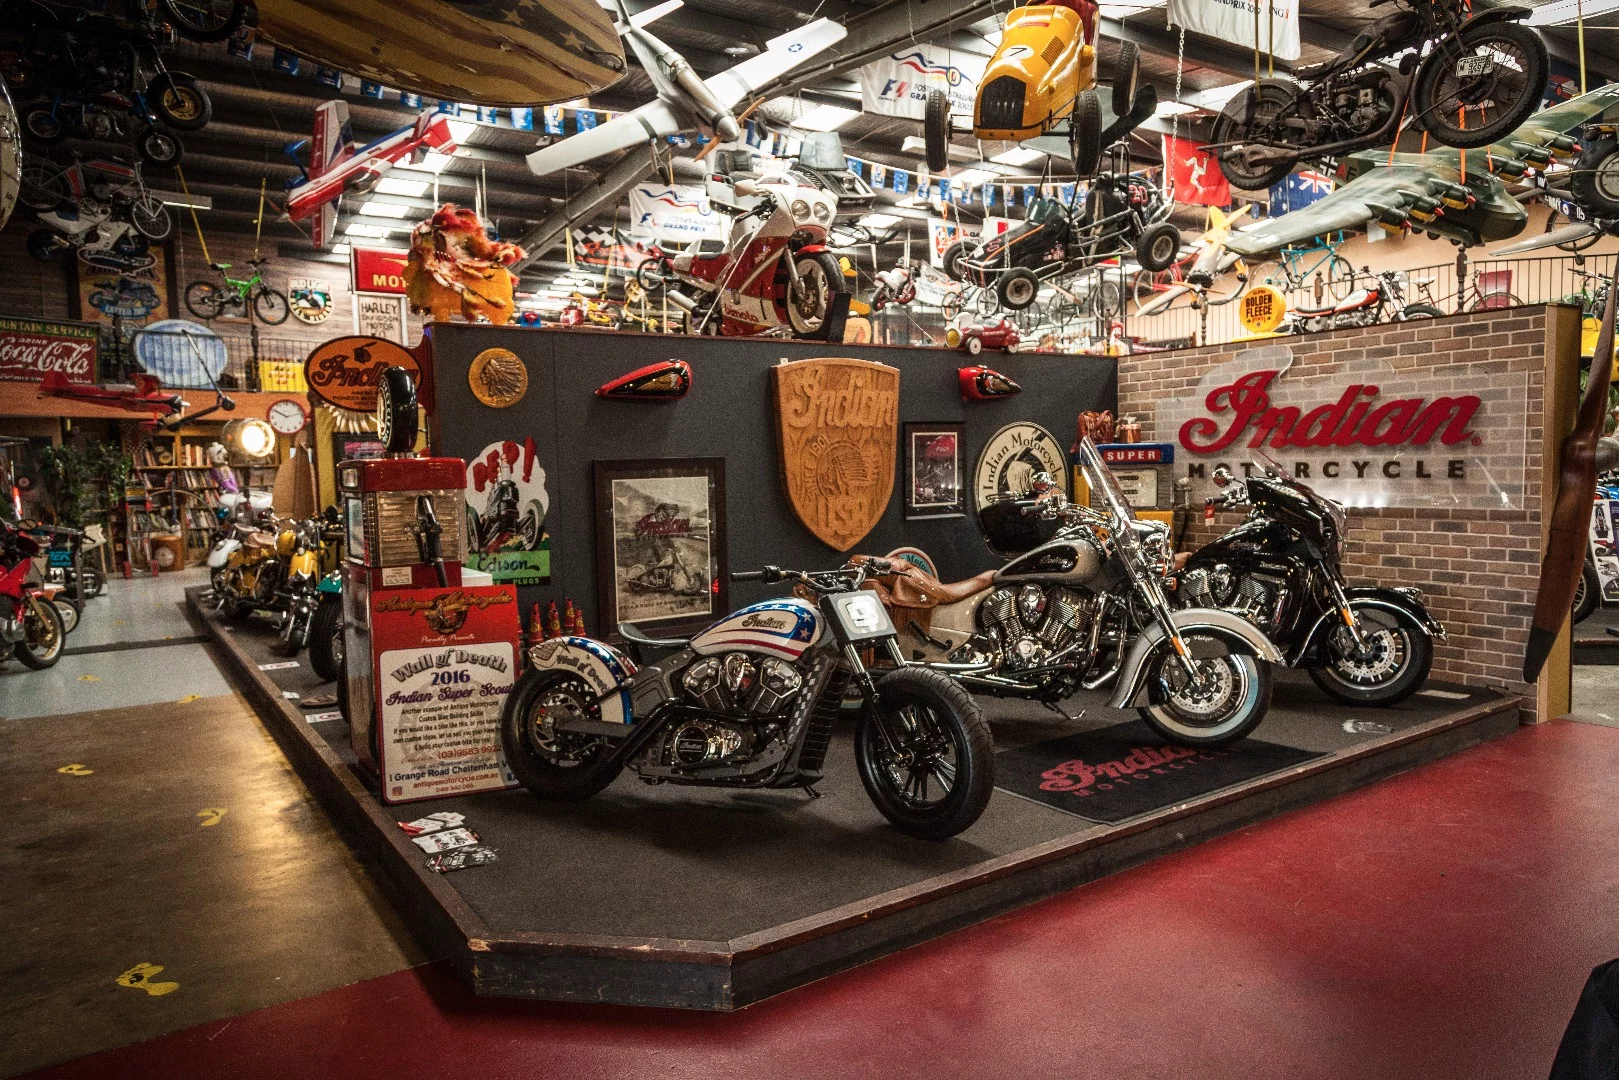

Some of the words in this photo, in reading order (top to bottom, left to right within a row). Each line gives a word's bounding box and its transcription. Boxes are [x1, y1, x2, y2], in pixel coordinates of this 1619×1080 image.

[1010, 47, 1027, 57] 7
[663, 222, 688, 231] GRAND
[1245, 294, 1272, 307] GOLDEN
[361, 303, 397, 314] HARLEY
[1246, 305, 1272, 318] FLEECE
[366, 322, 394, 331] MOTOR
[788, 365, 898, 428] Indian
[1178, 370, 1482, 454] Indian
[983, 447, 1010, 491] Indian
[1010, 432, 1065, 483] Motorcycle
[1107, 450, 1156, 460] SUPER
[477, 552, 541, 573] Edison
[513, 577, 540, 585] PLUGS
[741, 614, 787, 630] Indian
[390, 653, 434, 682] Wall
[435, 648, 455, 669] of
[455, 650, 508, 674] Death
[556, 654, 580, 667] Wall
[430, 669, 471, 686] 2016
[386, 690, 434, 706] Indian
[437, 685, 474, 702] Super
[450, 703, 469, 711] Antique
[470, 700, 499, 708] Motorcycles
[418, 715, 437, 723] Custom
[450, 711, 469, 720] Building
[438, 722, 448, 730] bike
[477, 719, 485, 727] you
[444, 739, 461, 747] custom
[394, 772, 426, 781] Grange
[427, 767, 450, 777] Road
[452, 761, 500, 774] Cheltenham
[413, 772, 499, 788] antiquemotorcycle.com.au
